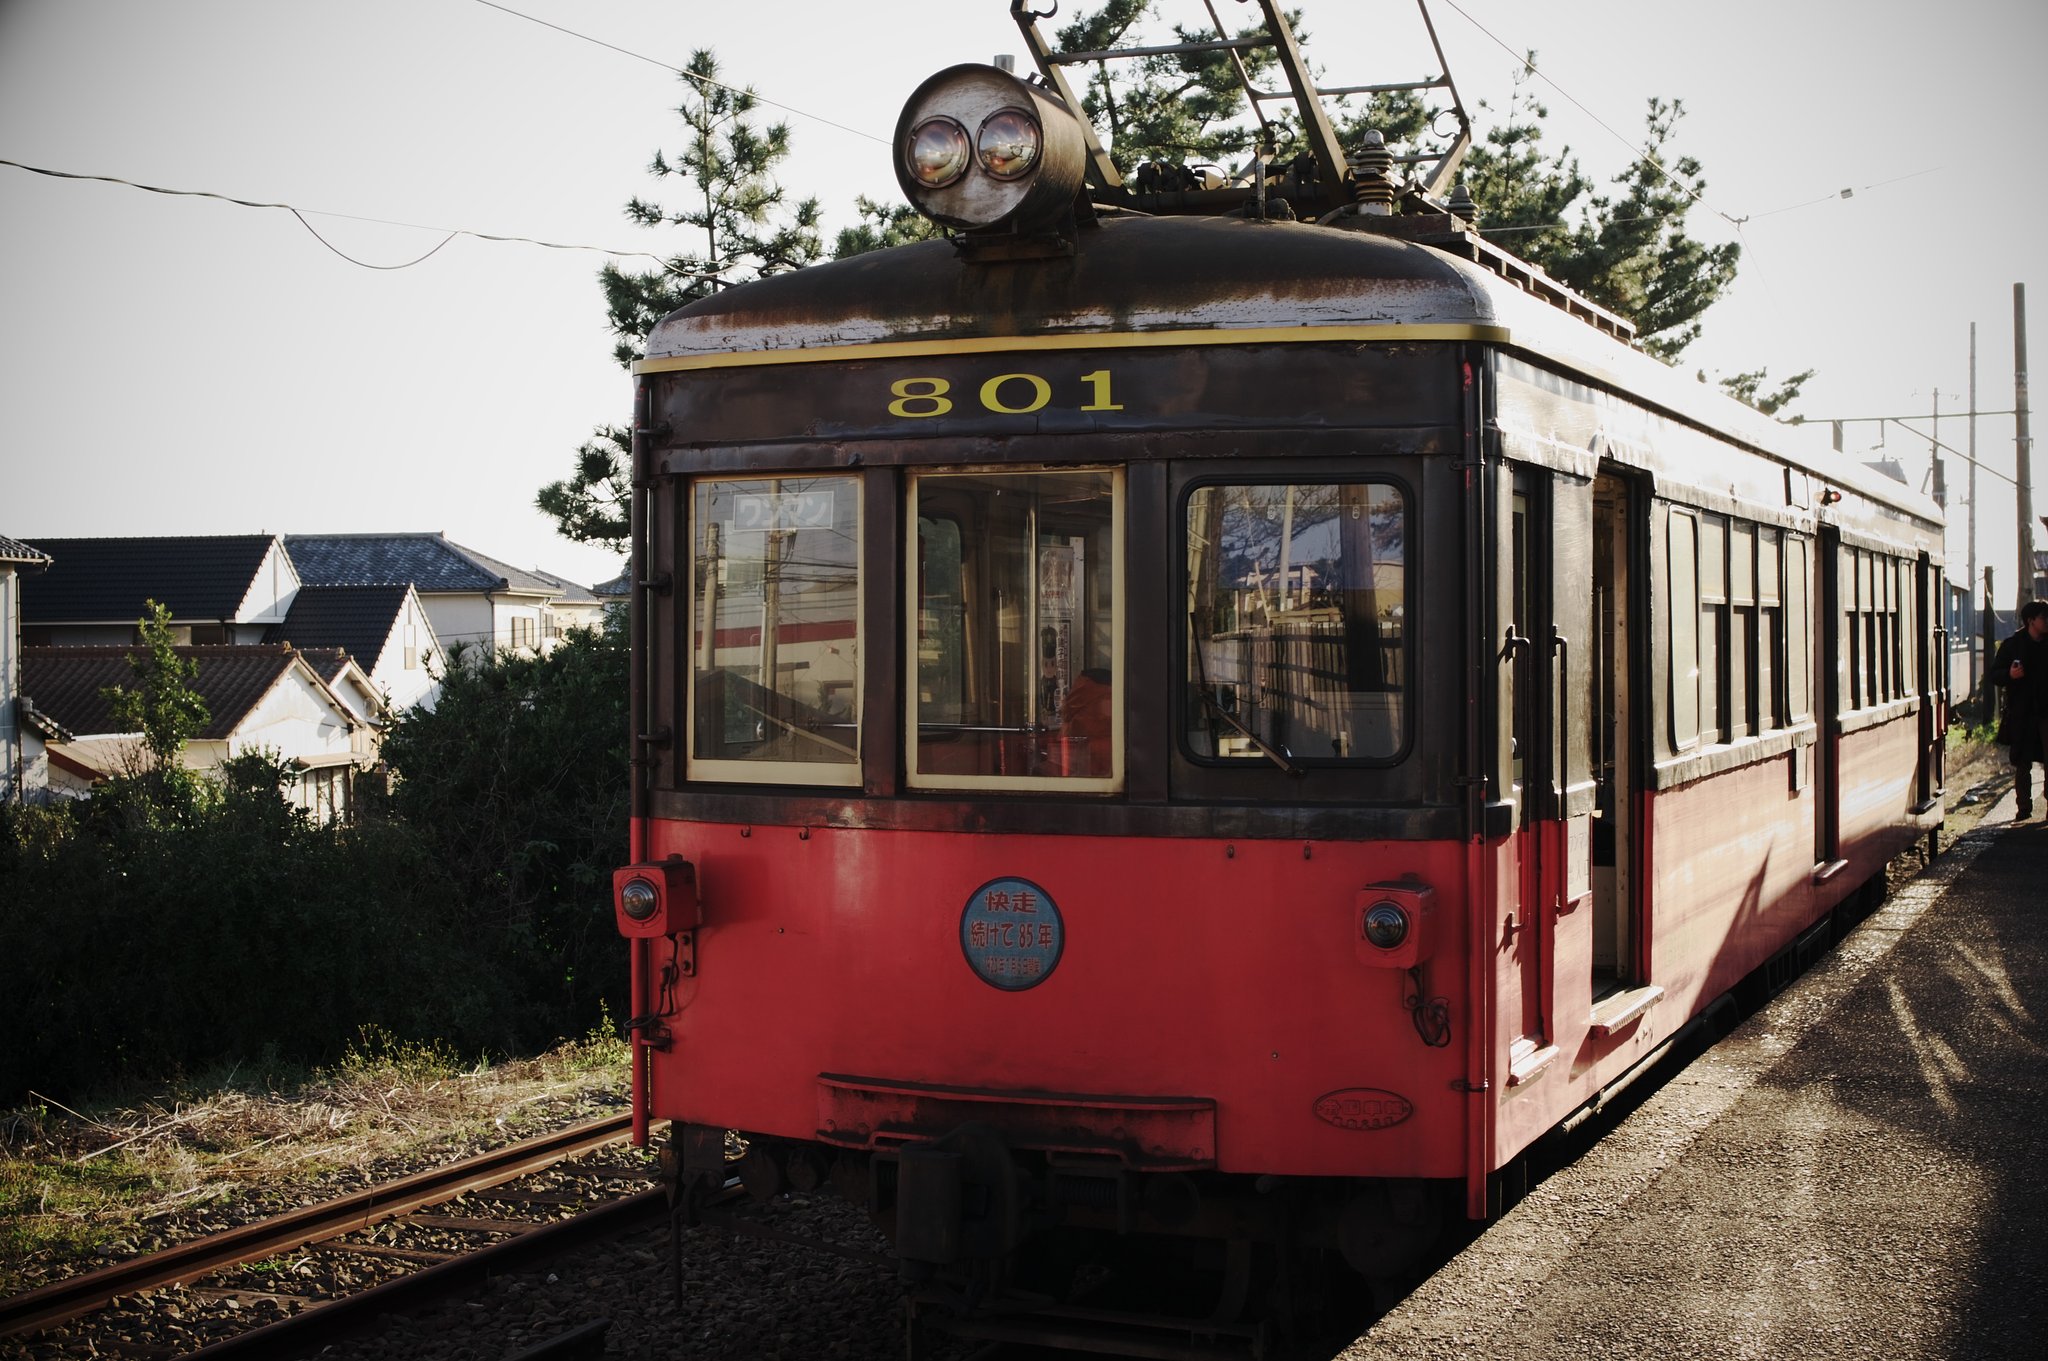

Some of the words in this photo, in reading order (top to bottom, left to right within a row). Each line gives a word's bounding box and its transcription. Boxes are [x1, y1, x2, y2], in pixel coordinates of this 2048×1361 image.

[888, 369, 1124, 418] 801
[739, 496, 828, 527] ワンマン
[985, 890, 1038, 914] 快走
